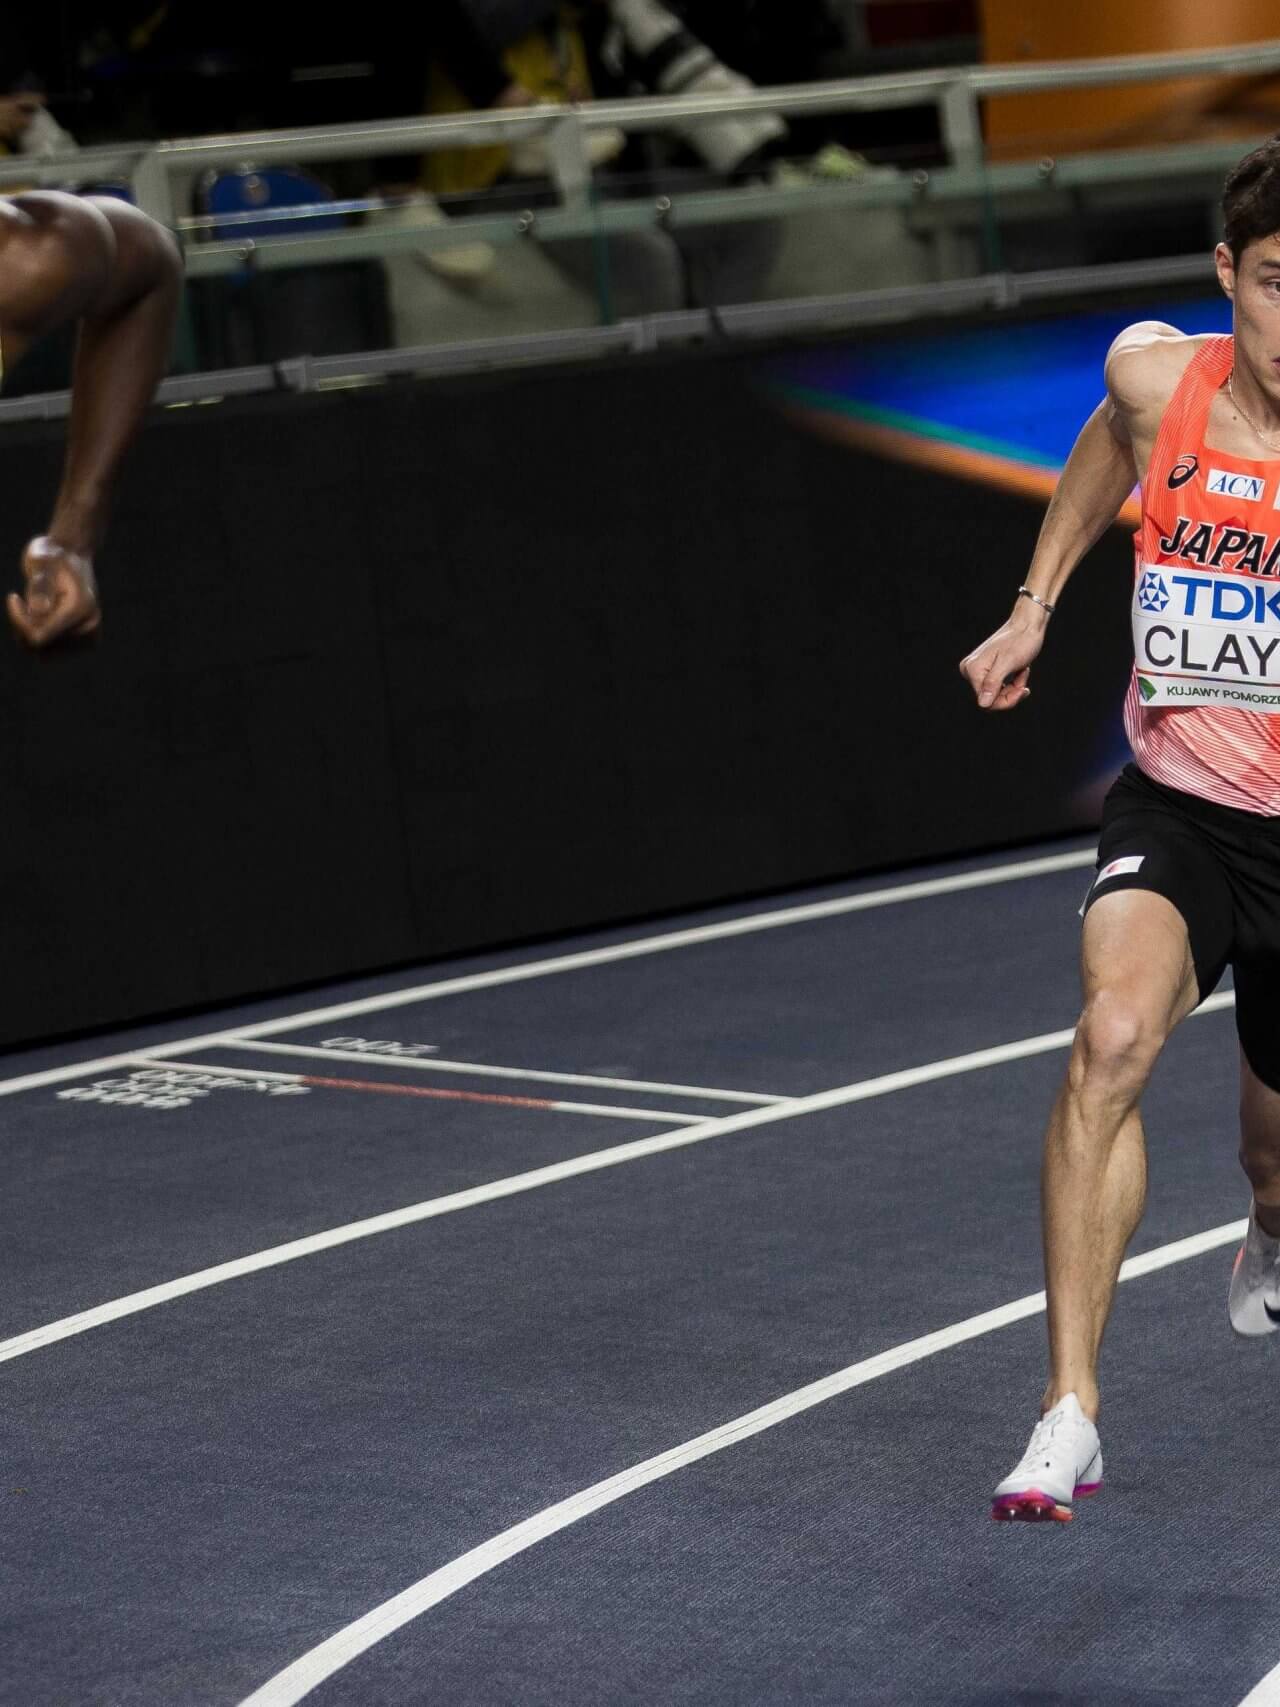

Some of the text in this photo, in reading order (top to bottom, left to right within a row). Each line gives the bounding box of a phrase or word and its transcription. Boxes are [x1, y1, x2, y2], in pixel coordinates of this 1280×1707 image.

[1211, 474, 1263, 498] ACN
[1144, 624, 1280, 677] CLAY
[1166, 685, 1220, 699] KUJAWY
